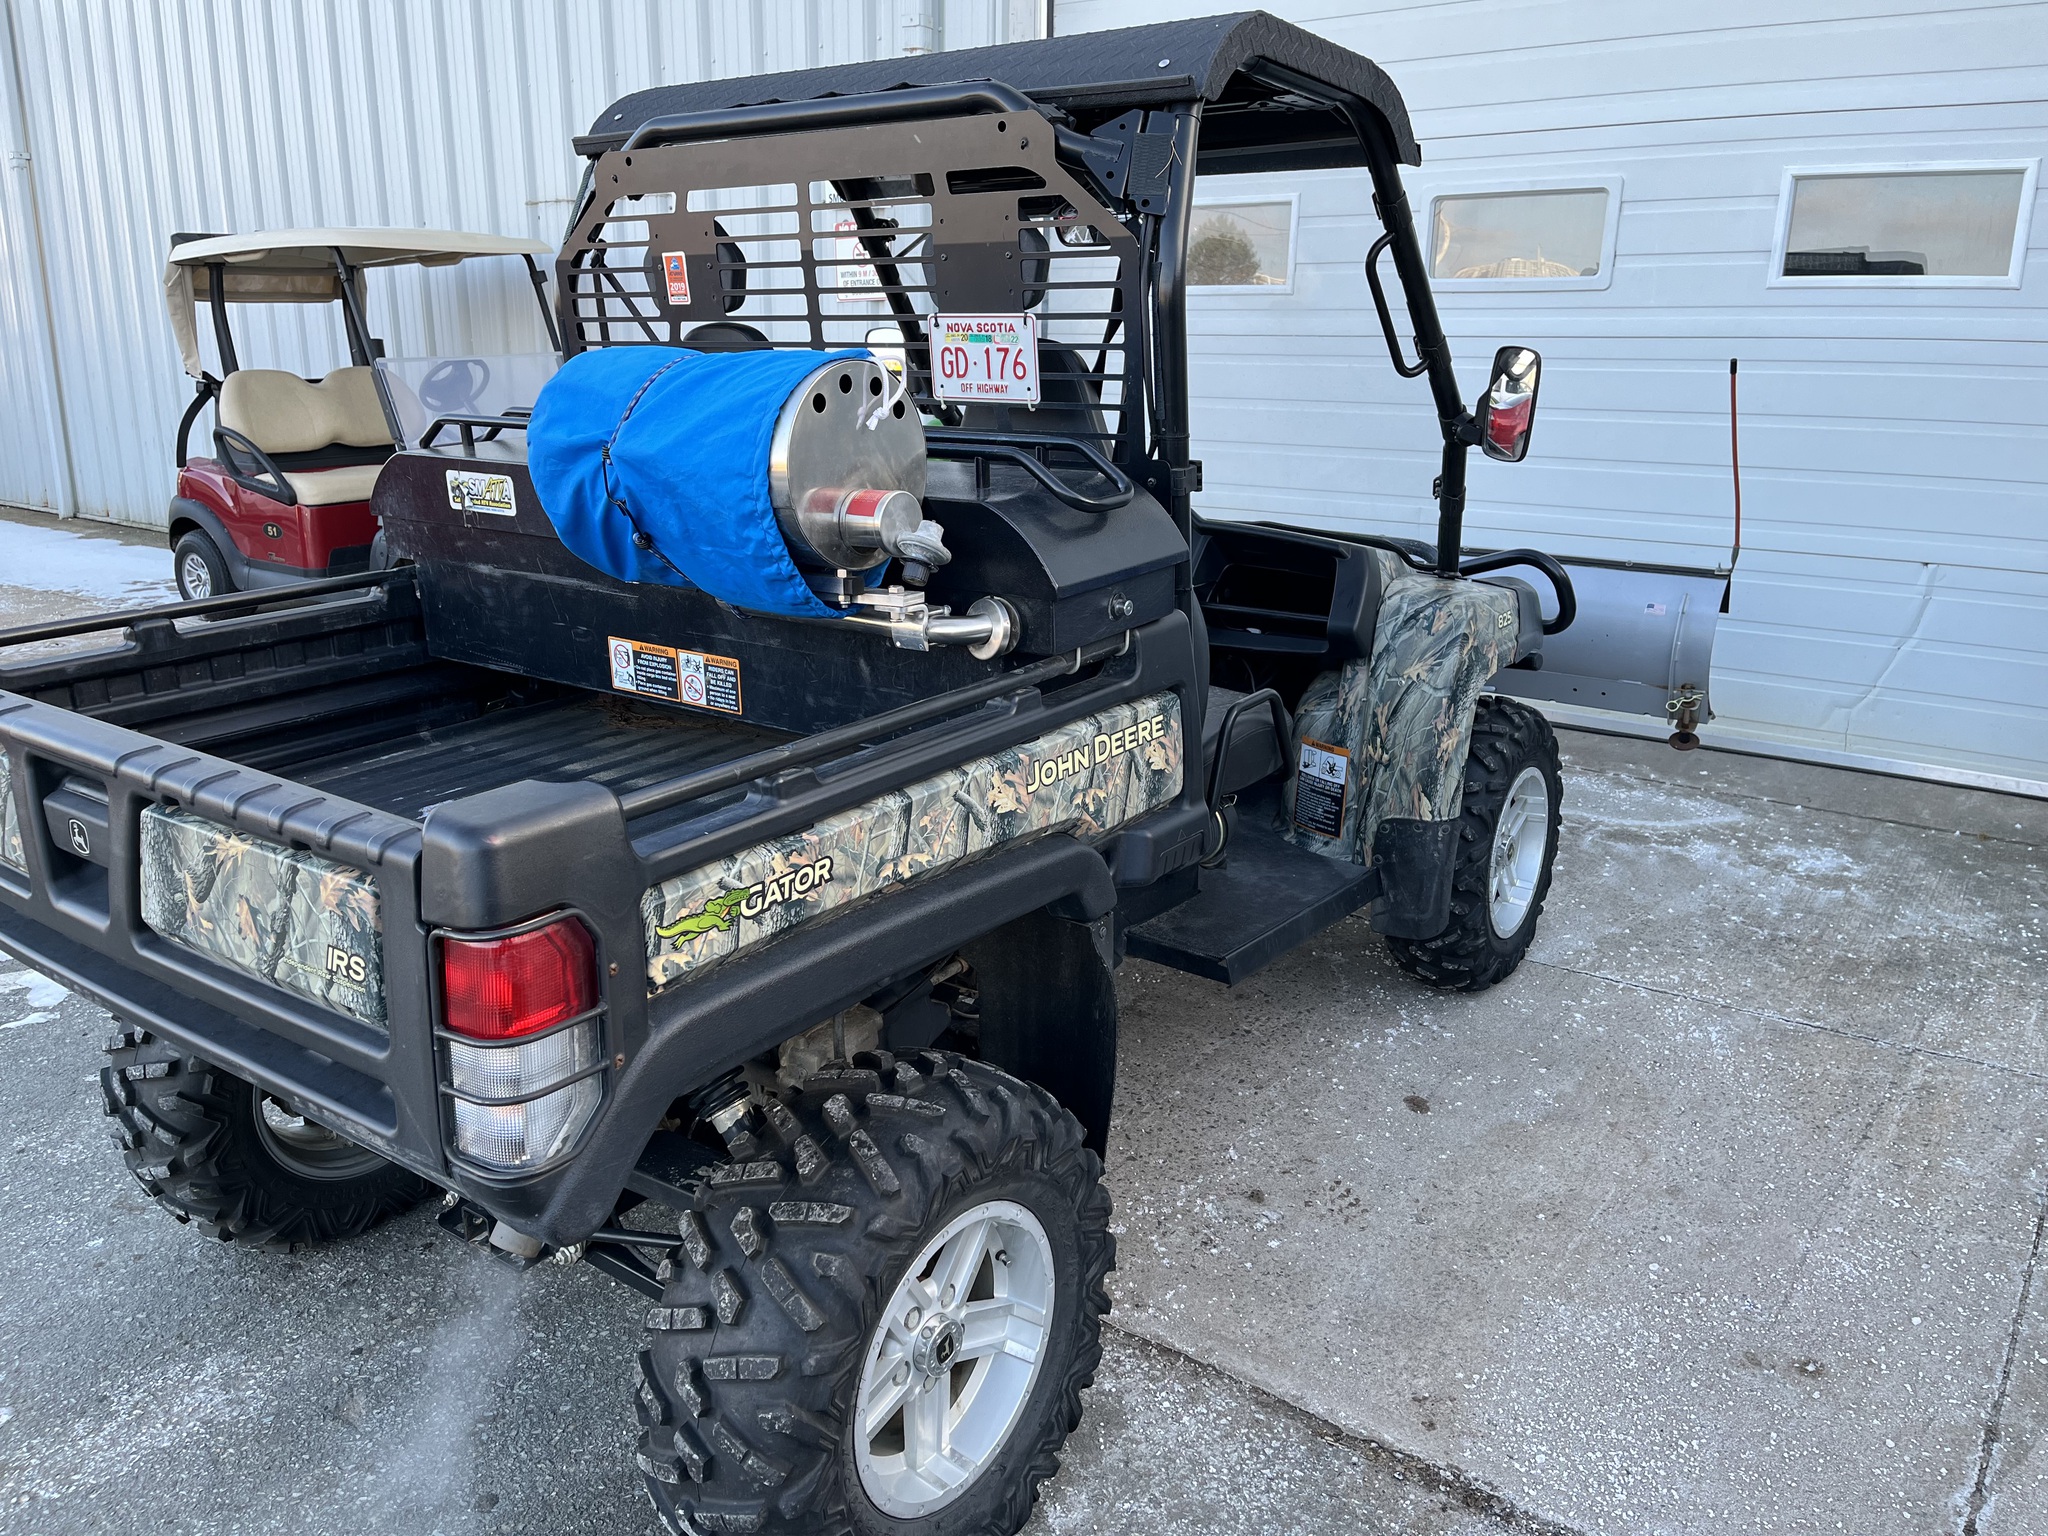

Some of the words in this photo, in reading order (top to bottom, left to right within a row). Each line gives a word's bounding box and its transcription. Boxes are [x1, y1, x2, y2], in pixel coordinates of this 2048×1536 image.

[670, 282, 686, 291] 2019
[946, 323, 974, 333] NOVA
[976, 323, 1016, 333] SCOTIA
[960, 333, 969, 342] 20
[1010, 335, 1019, 344] 22
[960, 383, 973, 393] OFF
[976, 383, 1009, 394] HIGHWAY
[267, 525, 277, 537] 51
[1498, 610, 1512, 629] 825
[643, 644, 669, 656] WARNING
[711, 657, 737, 667] WARNING
[1027, 745, 1090, 794] JOHN
[1094, 714, 1165, 764] DEERE
[740, 857, 833, 919] GATOR
[327, 944, 366, 982] IRS
